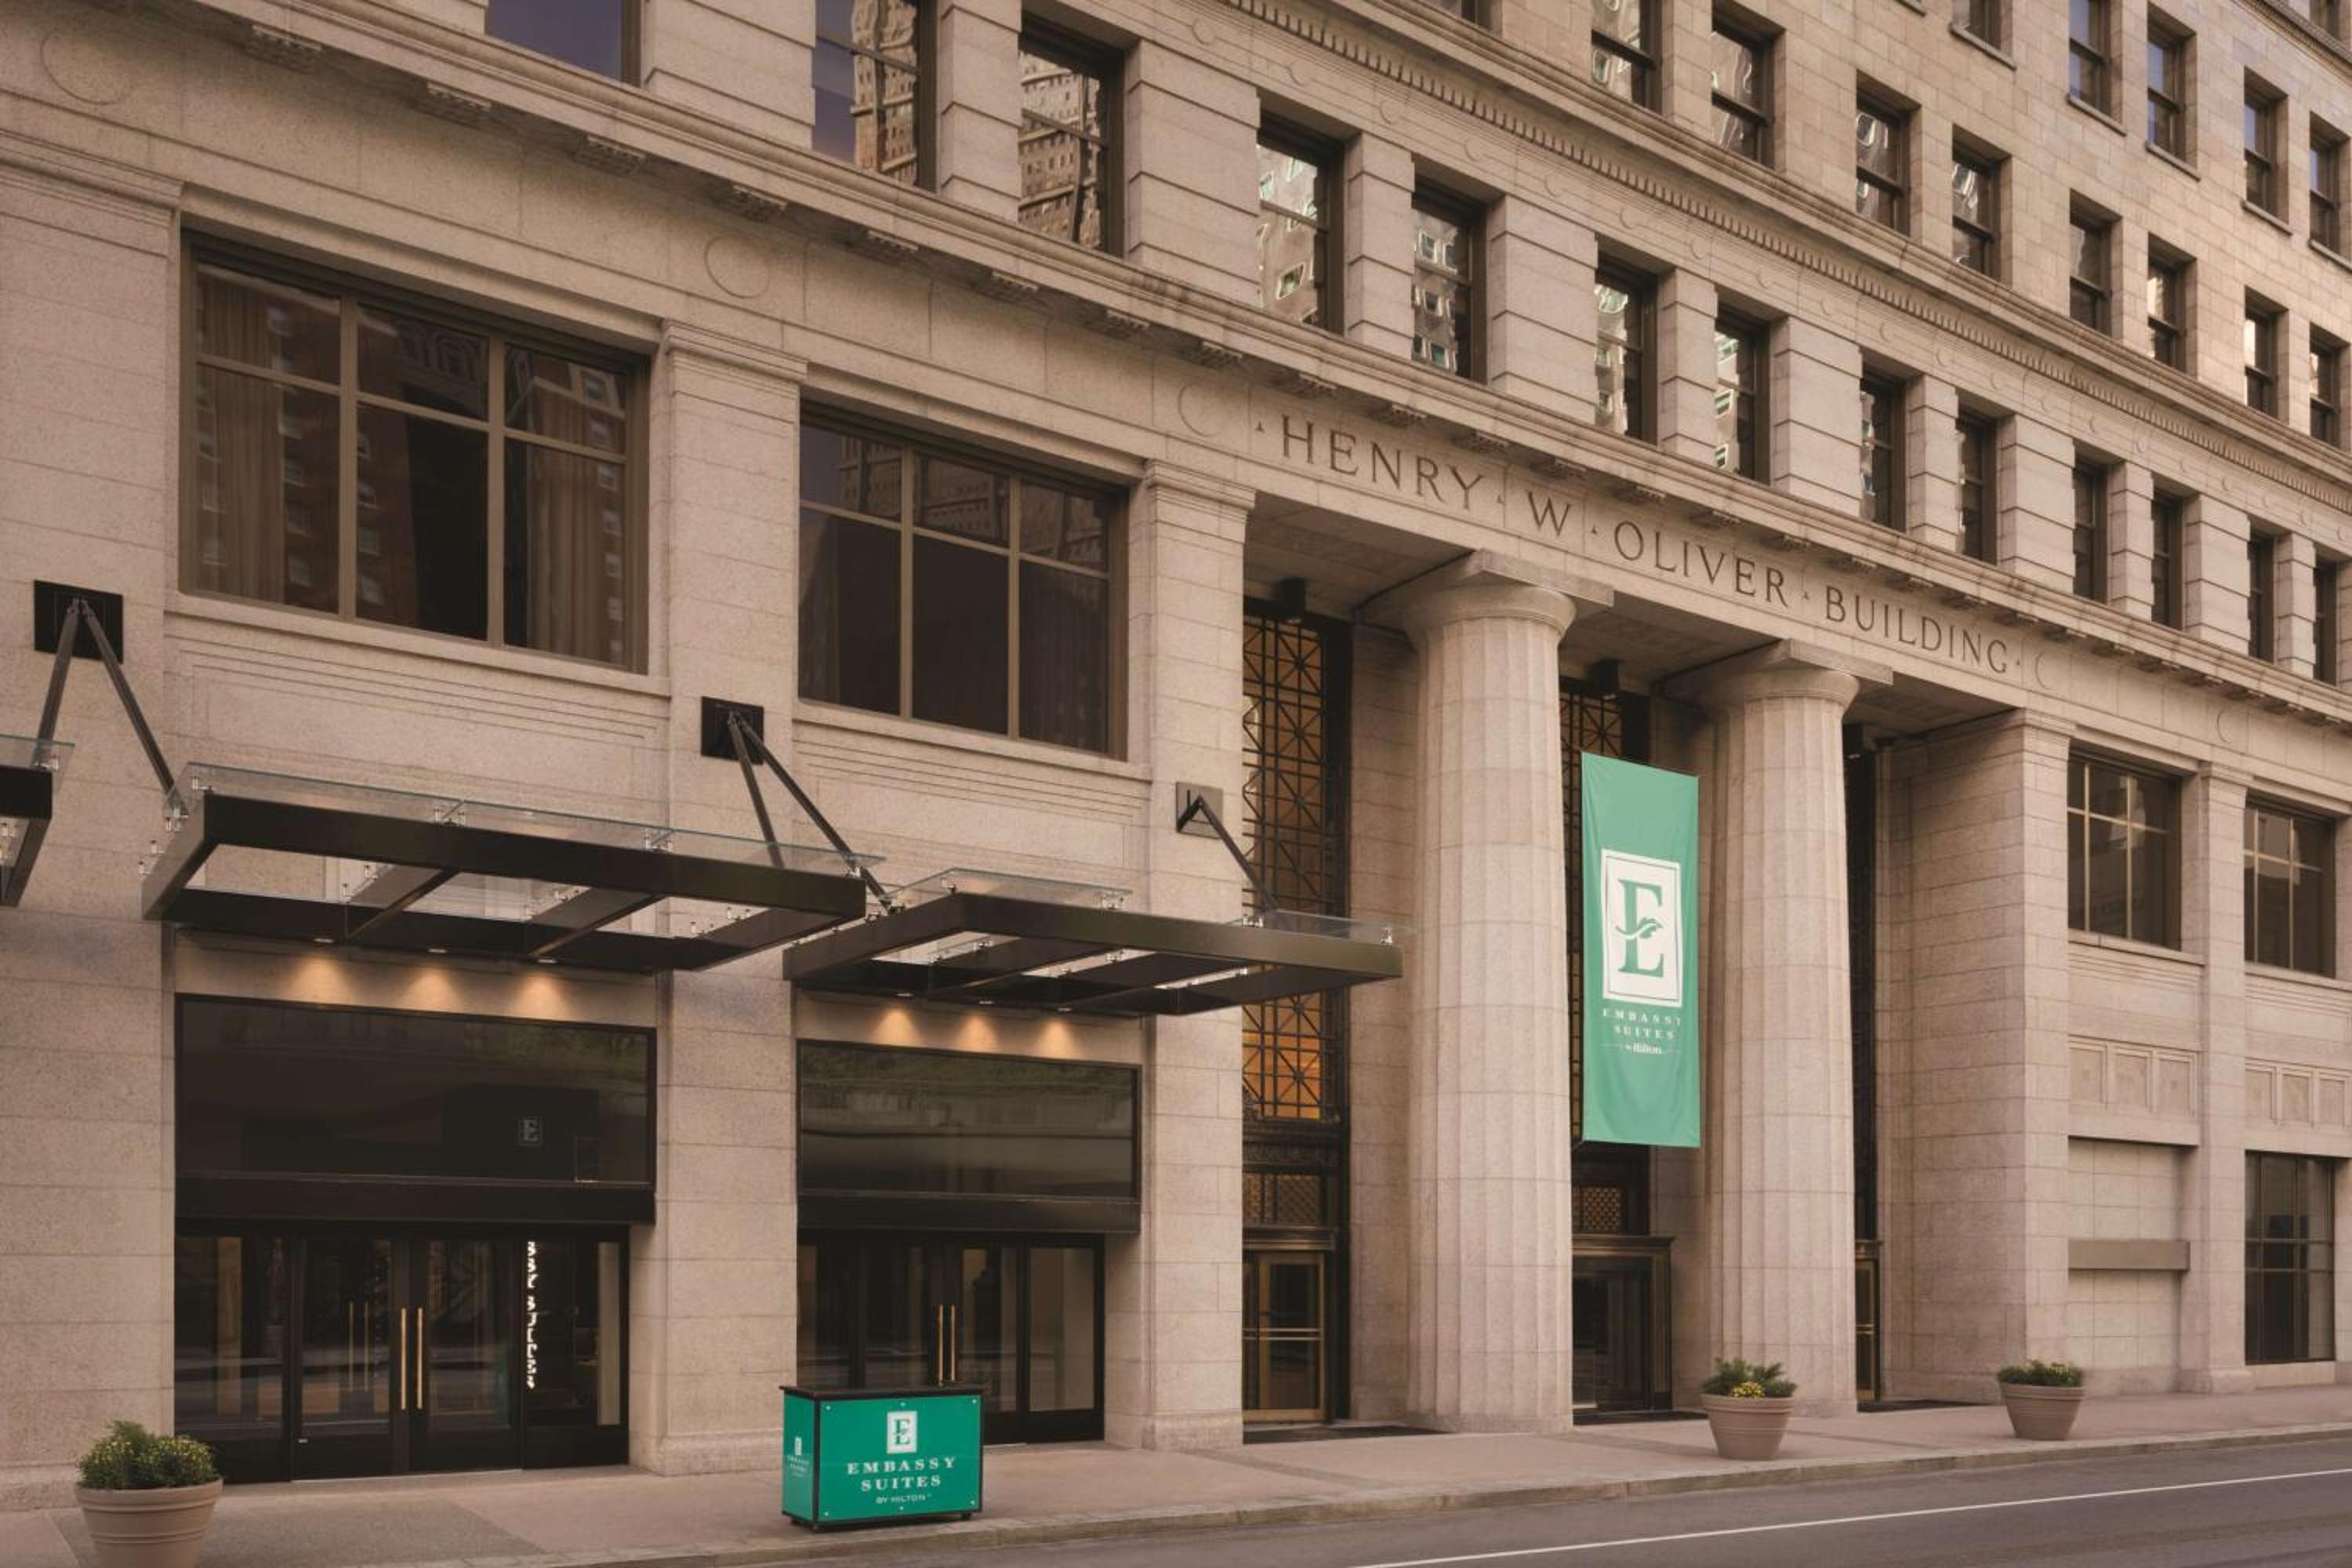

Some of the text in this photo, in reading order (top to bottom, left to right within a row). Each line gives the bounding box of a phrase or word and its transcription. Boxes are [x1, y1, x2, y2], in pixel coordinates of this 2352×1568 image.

[1281, 413, 2008, 674] HENRY W OLIVER BUILDING
[1616, 878, 1664, 979] E
[1613, 1025, 1675, 1040] SUITES
[893, 1417, 912, 1446] E
[846, 1457, 956, 1475] EMBASSY
[861, 1475, 942, 1492] SUITES
